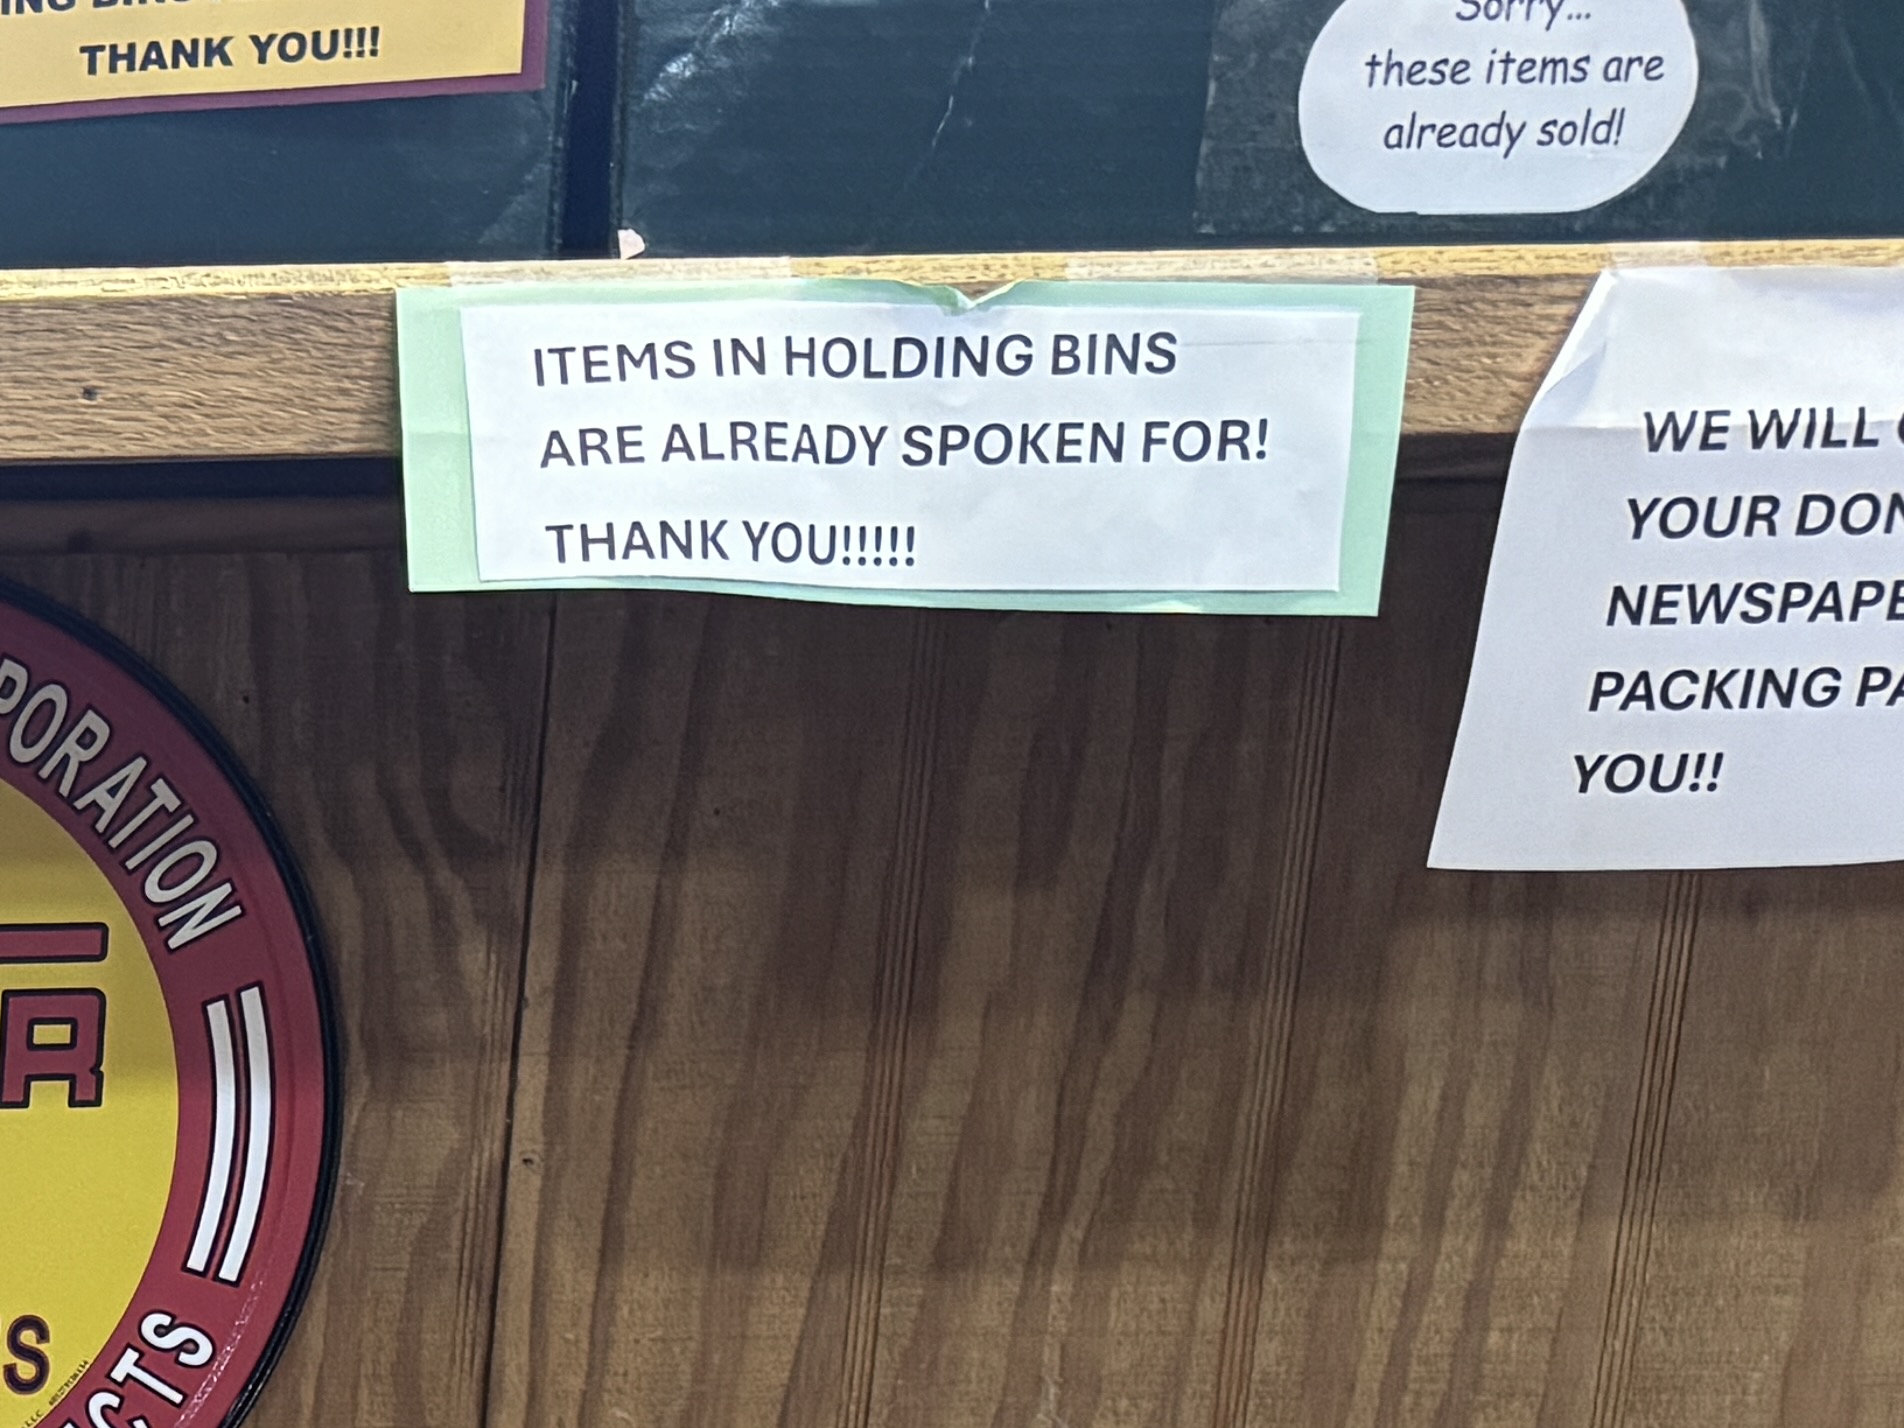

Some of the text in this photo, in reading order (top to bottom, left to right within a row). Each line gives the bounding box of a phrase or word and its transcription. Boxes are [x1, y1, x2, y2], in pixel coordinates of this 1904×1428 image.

[80, 36, 234, 75] THANK
[249, 27, 381, 65] YOU!!!
[1365, 49, 1665, 87] these items are
[1383, 108, 1625, 158] already sold!
[533, 331, 1178, 386] ITEMS IN HOLDING BINS
[540, 417, 1269, 468] ARE ALREADY SPOKEN FOR!
[1644, 409, 1731, 452] WE
[1748, 407, 1879, 450] WILL
[1627, 495, 1781, 540] YOUR
[545, 519, 917, 567] THANK YOU!!!!!
[1589, 667, 1842, 712] PACKING
[1574, 753, 1724, 793] YOU!!
